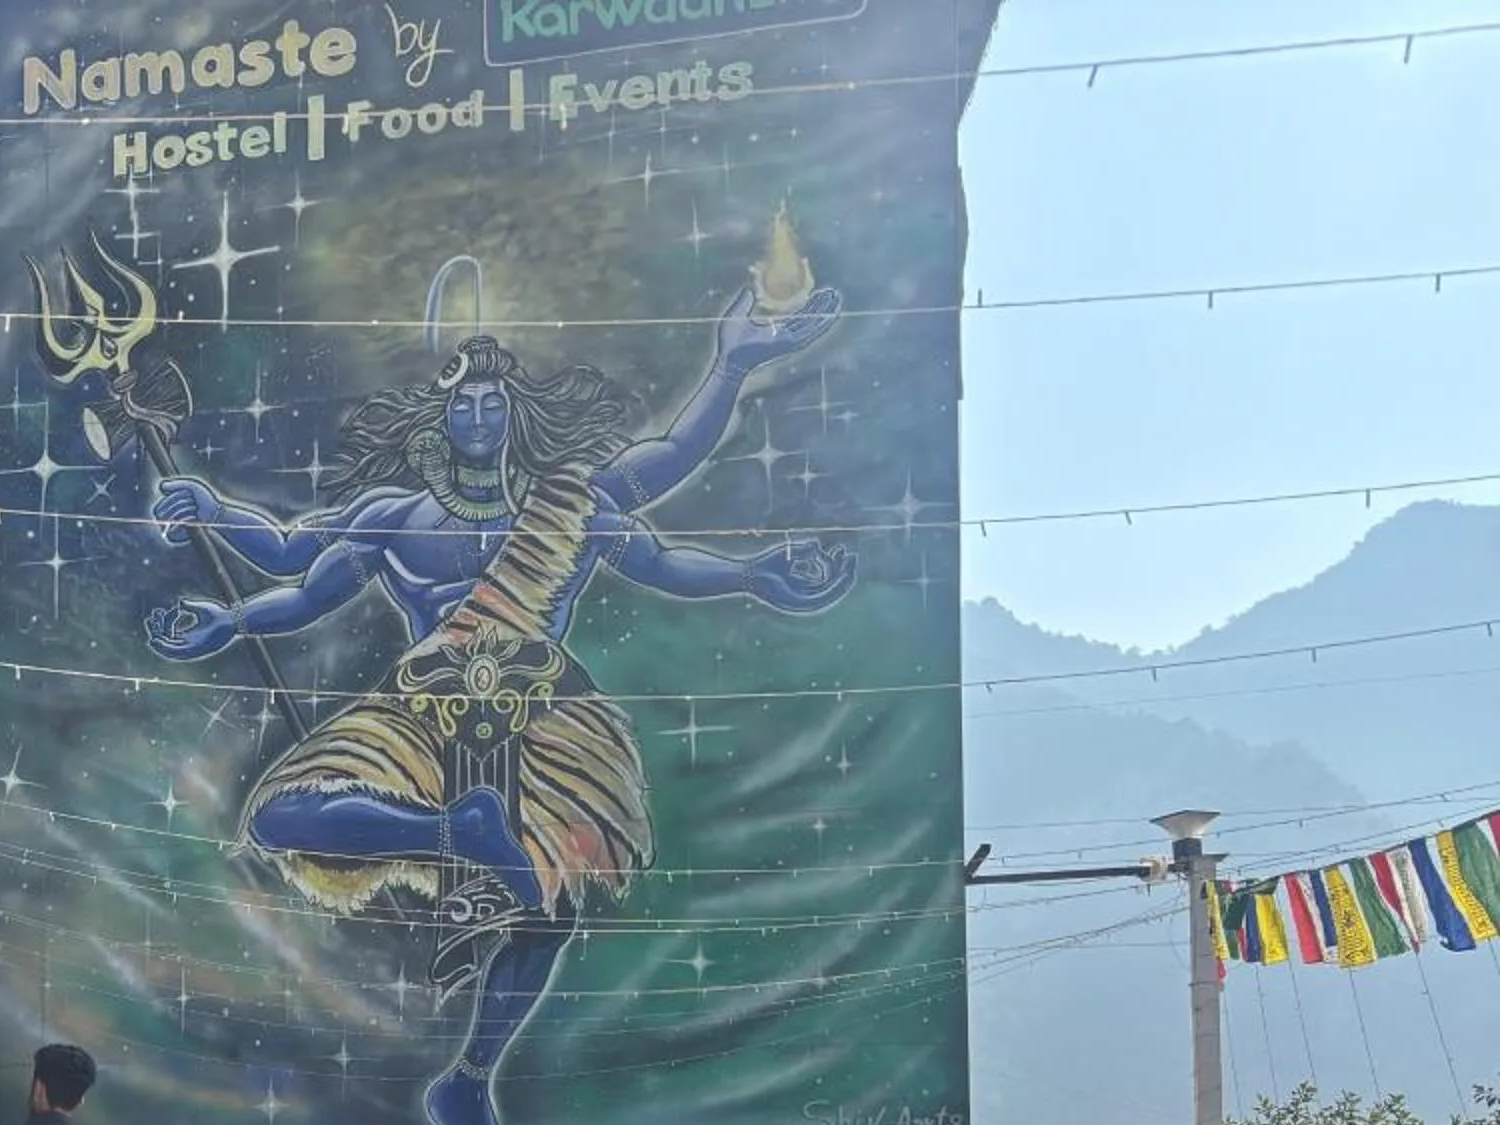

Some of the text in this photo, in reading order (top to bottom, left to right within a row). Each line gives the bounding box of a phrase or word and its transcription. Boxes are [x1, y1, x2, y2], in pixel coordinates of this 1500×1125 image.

[23, 2, 454, 115] Namaste by
[112, 110, 288, 177] Hostel
[346, 88, 485, 142] Food
[549, 58, 754, 122] Events
